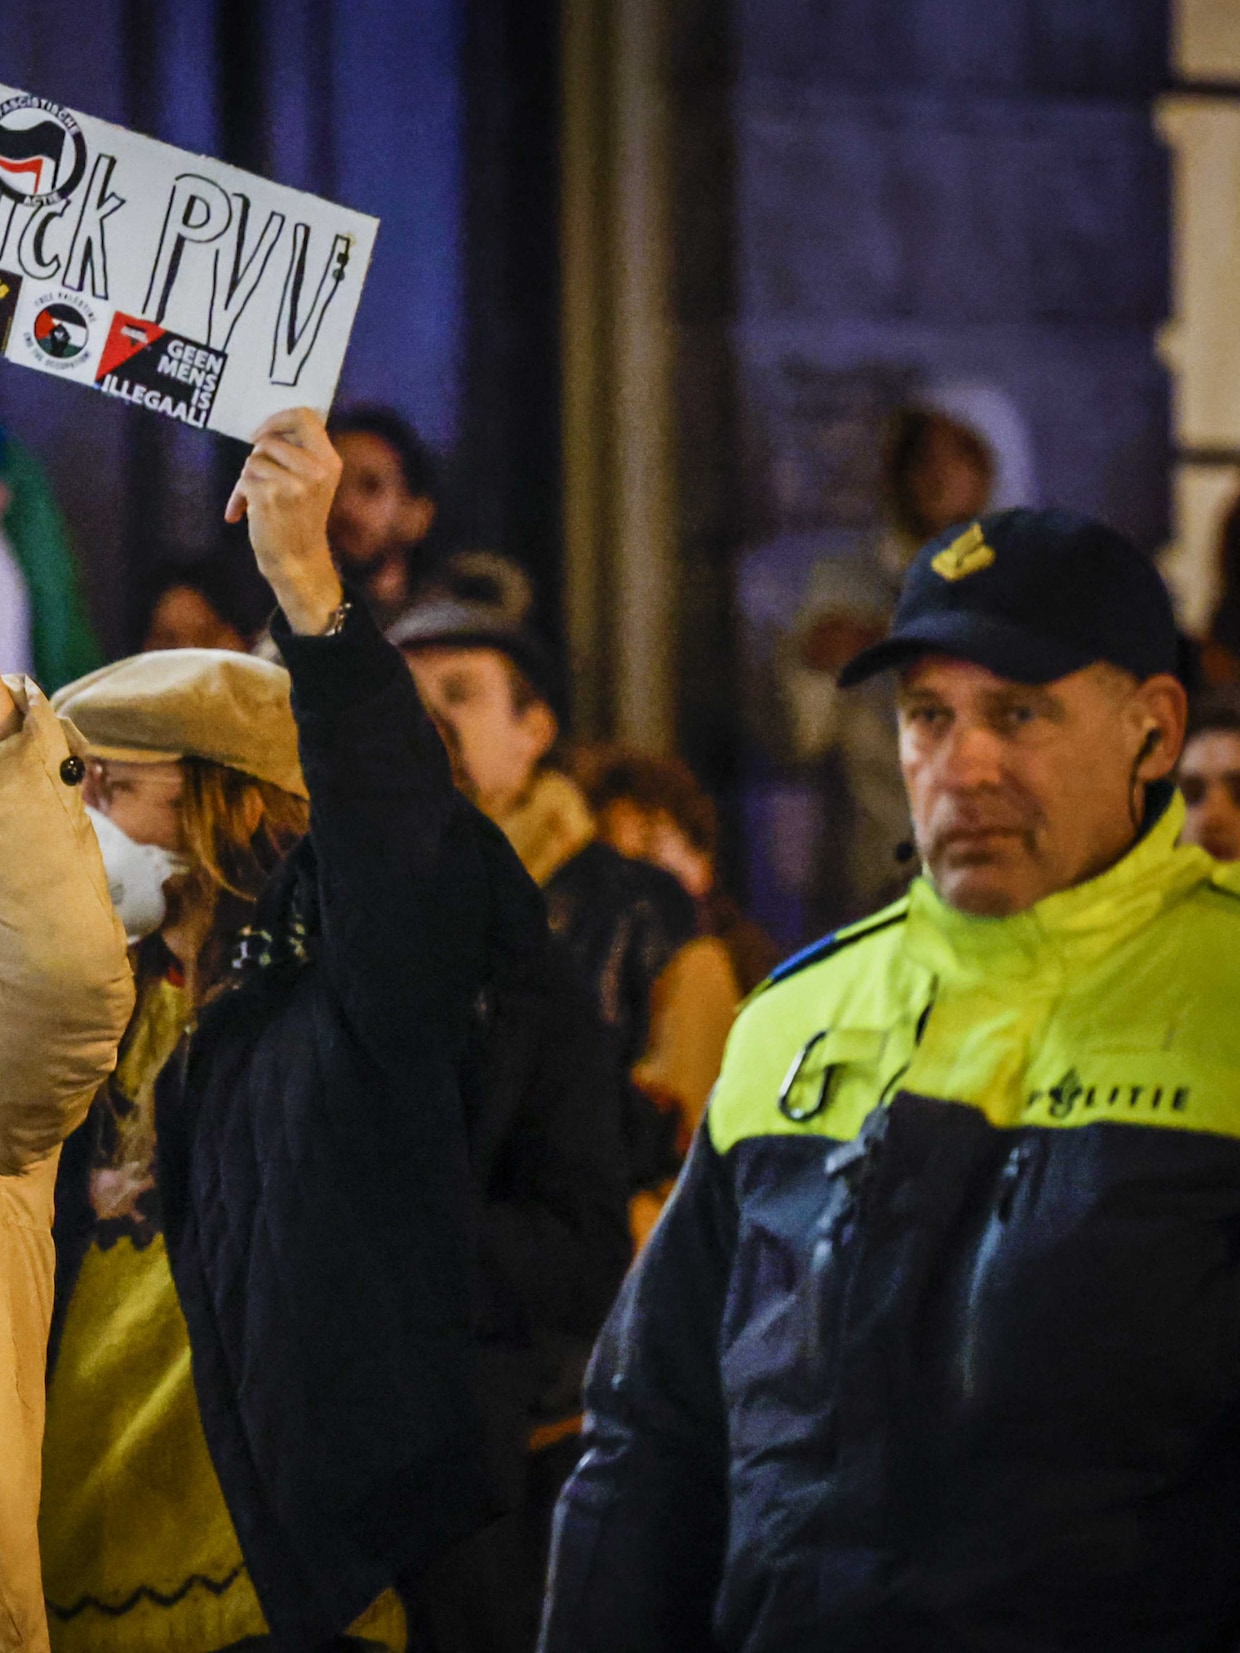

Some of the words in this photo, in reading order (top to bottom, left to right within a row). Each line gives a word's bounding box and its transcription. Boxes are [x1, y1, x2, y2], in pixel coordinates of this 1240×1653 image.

[142, 173, 350, 387] PVV
[157, 354, 219, 393] MENS
[167, 339, 224, 375] GEEN
[191, 387, 213, 411] IS
